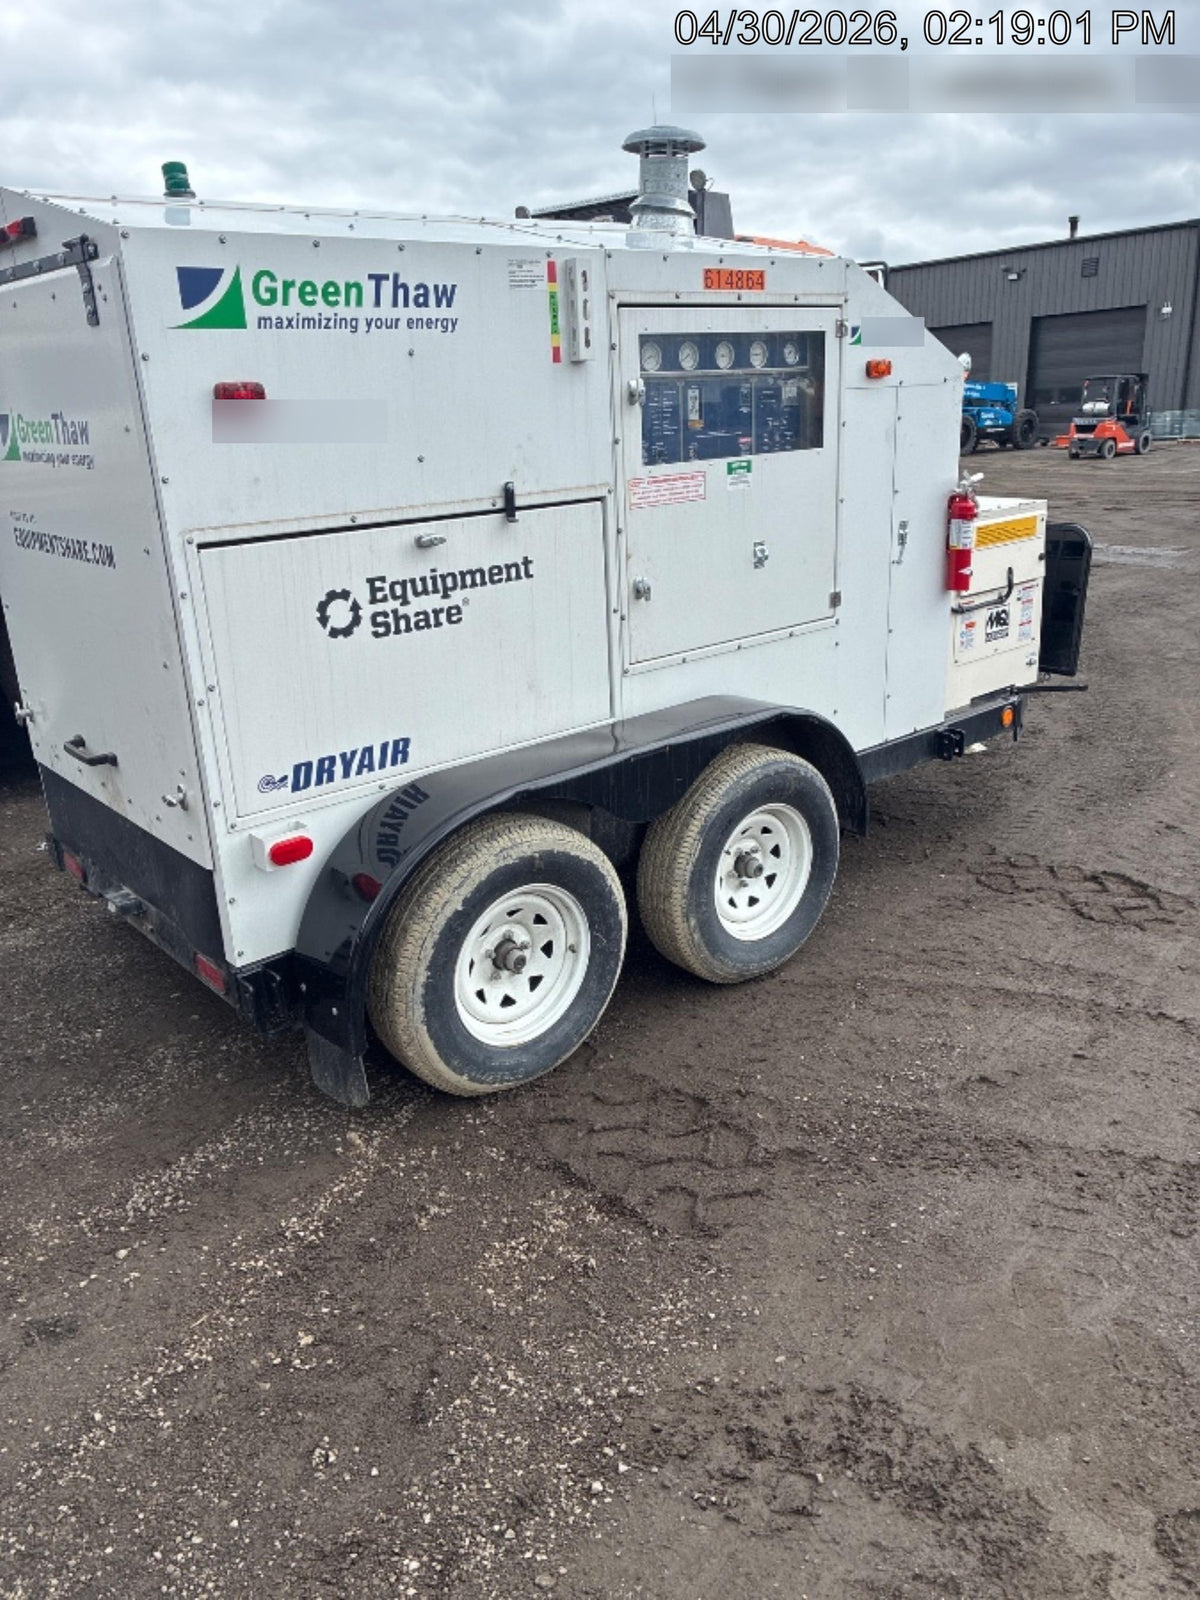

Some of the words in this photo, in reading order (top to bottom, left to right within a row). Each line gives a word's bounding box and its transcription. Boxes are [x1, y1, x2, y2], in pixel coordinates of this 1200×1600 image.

[252, 269, 458, 308] GreenThaw
[704, 271, 764, 290] 614864
[256, 312, 358, 333] maximizing
[365, 315, 400, 333] your
[406, 317, 459, 333] energy
[17, 410, 89, 445] GreenThaw
[366, 556, 535, 606] Equipment
[291, 737, 412, 793] DRYAIR
